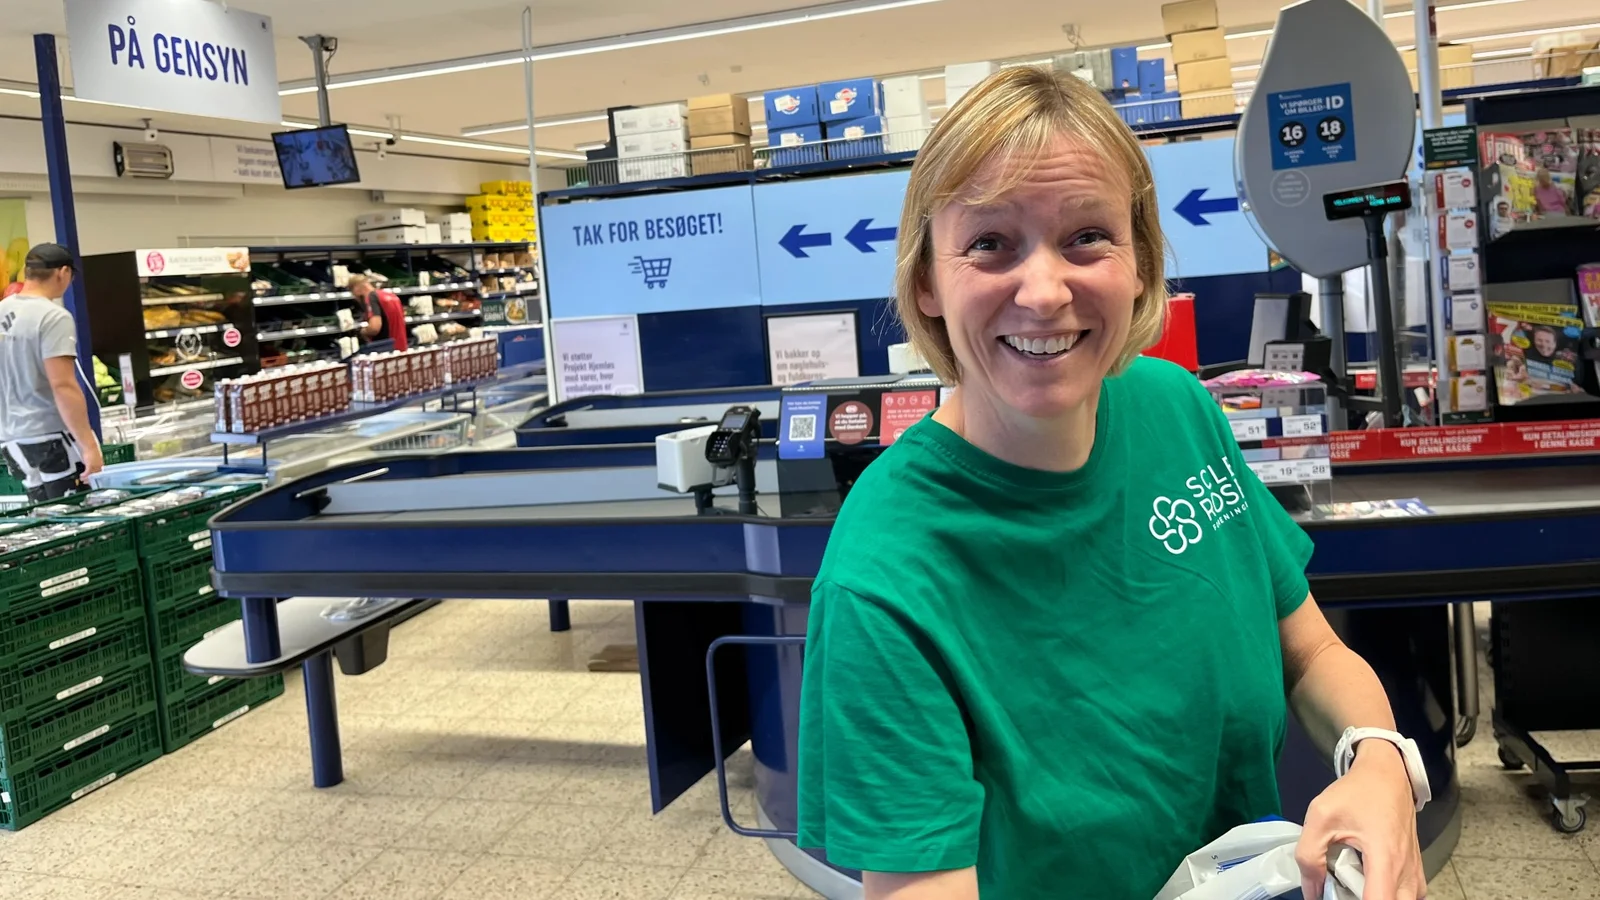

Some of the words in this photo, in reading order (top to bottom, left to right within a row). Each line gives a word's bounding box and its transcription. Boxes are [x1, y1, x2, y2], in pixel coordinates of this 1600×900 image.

[108, 15, 145, 69] PÅ
[153, 32, 249, 86] GENSYN
[1279, 102, 1288, 110] VI
[1288, 97, 1322, 108] SPØRGER
[1284, 108, 1297, 116] OM
[1282, 125, 1303, 141] 16
[1320, 120, 1341, 136] 18
[572, 223, 604, 247] TAK
[609, 219, 639, 243] FOR
[645, 212, 724, 241] BESØGET!
[562, 353, 569, 361] Vi
[571, 352, 593, 361] støtter
[775, 350, 783, 359] Vi
[784, 349, 809, 359] bakker
[811, 350, 821, 359] op
[564, 363, 587, 373] Projekt
[776, 362, 787, 371] om
[564, 374, 579, 382] med
[600, 372, 614, 380] hvor
[777, 374, 786, 383] og
[1400, 438, 1417, 447] KUN
[1419, 435, 1483, 446] BETALINGSKORT
[1523, 433, 1540, 441] KUN
[1540, 440, 1567, 449] DENNE
[1569, 438, 1595, 447] KASSE
[1417, 445, 1444, 454] DENNE
[1446, 444, 1472, 453] KASSE
